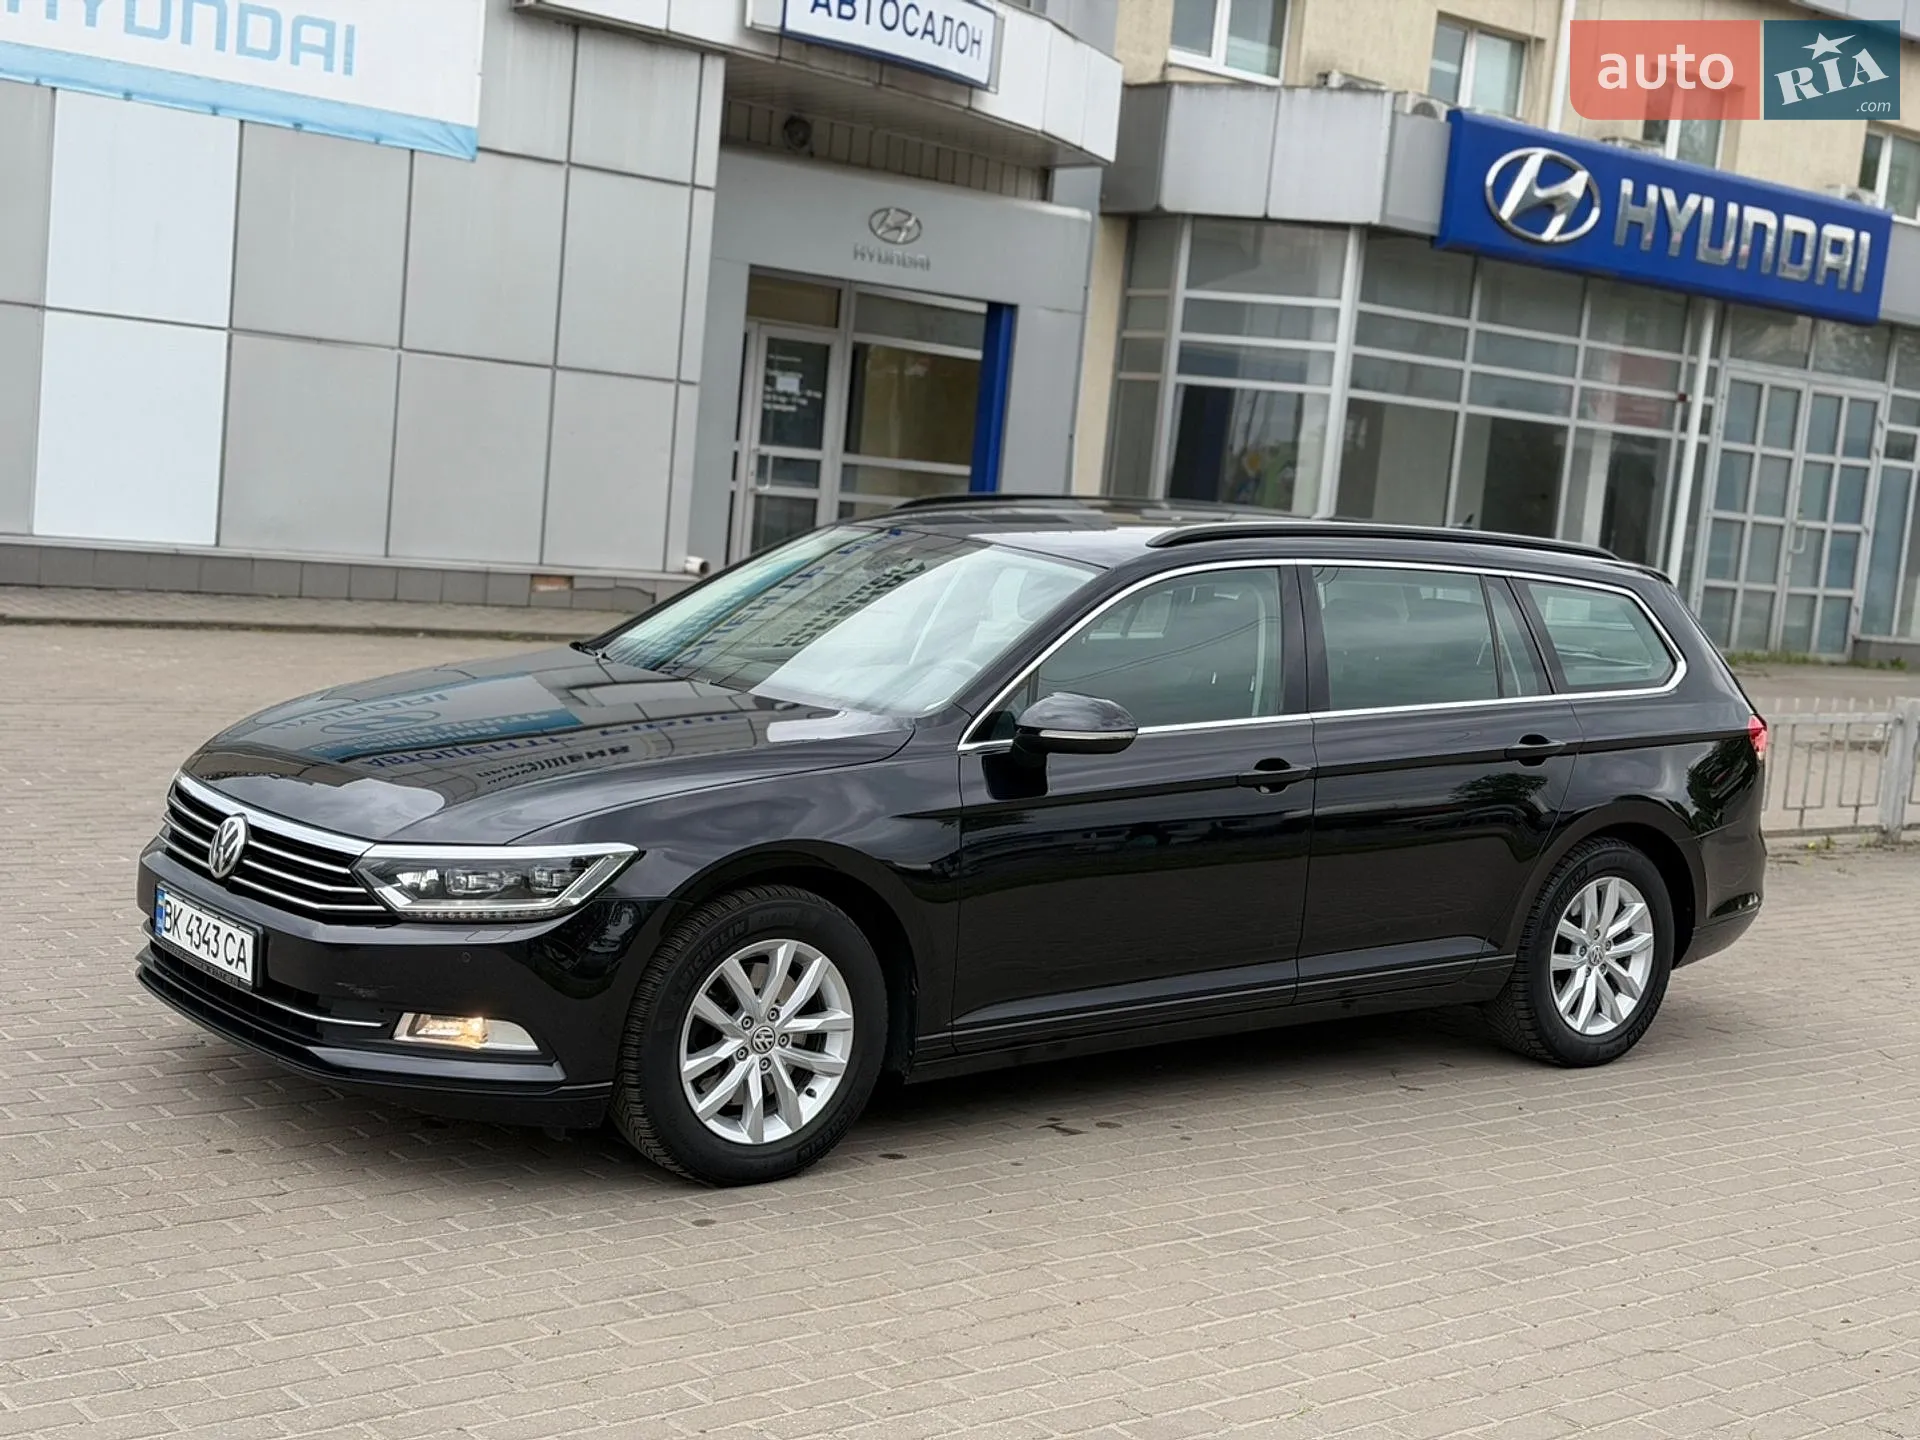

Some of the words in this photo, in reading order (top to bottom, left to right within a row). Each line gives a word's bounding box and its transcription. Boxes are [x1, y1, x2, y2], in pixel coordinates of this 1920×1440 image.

[853, 242, 931, 271] HYUNDAI
[1613, 178, 1871, 293] HYUNDAI
[164, 900, 183, 940] BK
[186, 914, 221, 958] 4343
[224, 932, 247, 973] CA
